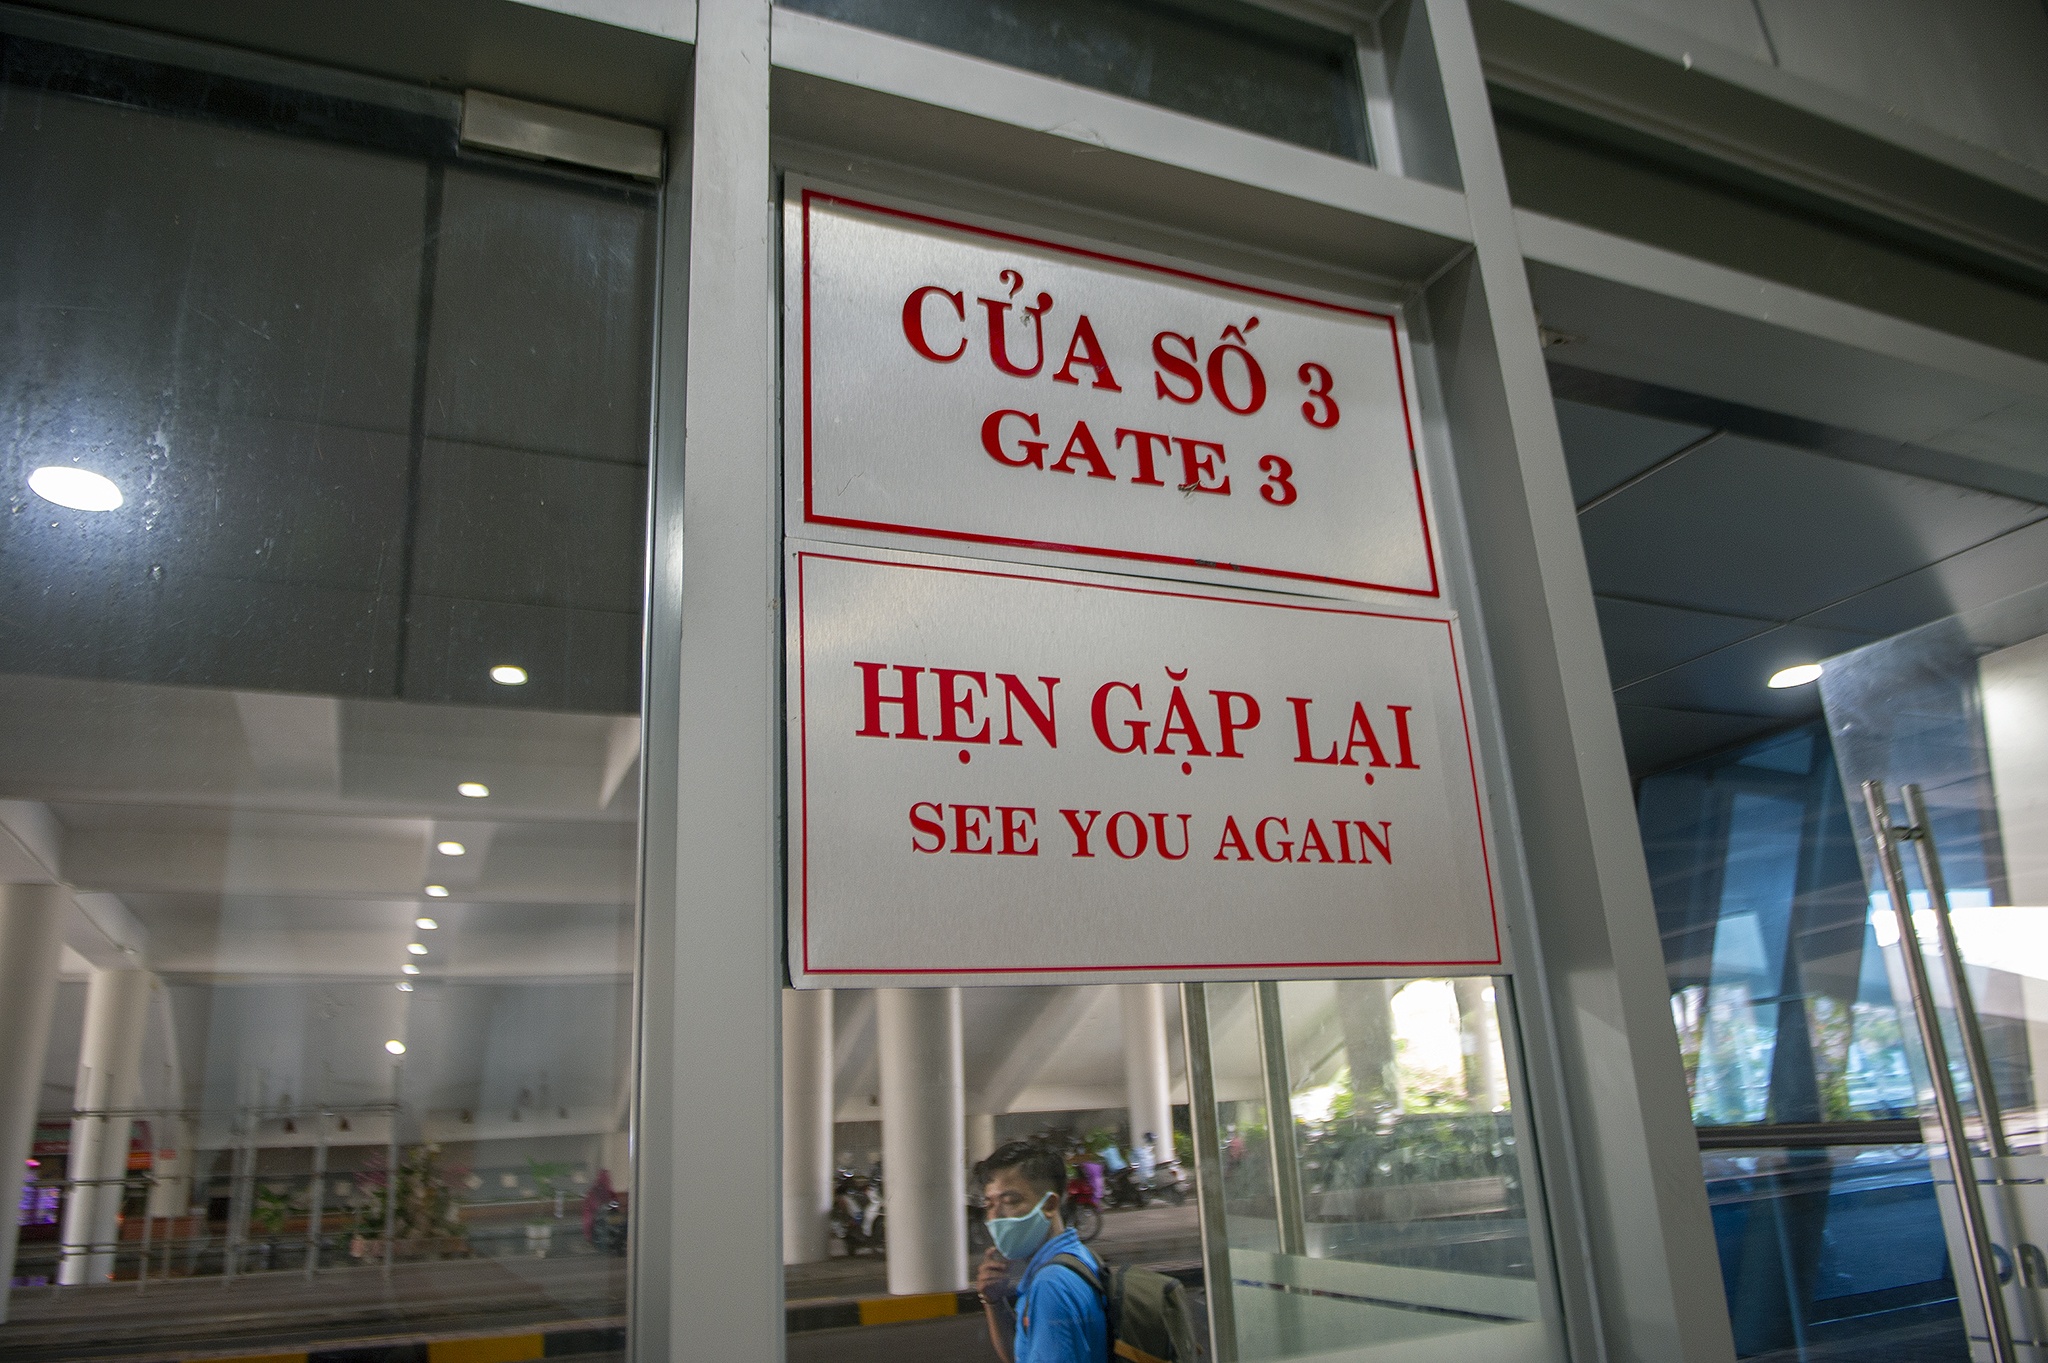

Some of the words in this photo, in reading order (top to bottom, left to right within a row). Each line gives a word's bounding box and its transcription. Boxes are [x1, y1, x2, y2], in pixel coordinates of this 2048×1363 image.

[902, 269, 1122, 392] CỬA
[1152, 316, 1267, 415] SỐ
[1298, 362, 1341, 429] 3
[981, 409, 1231, 496] GATE
[1259, 455, 1297, 506] 3
[854, 661, 1061, 764] HẸN
[1091, 665, 1261, 775] GẶP
[1286, 697, 1420, 785] LẠI
[909, 802, 1039, 856] SEE
[1059, 809, 1192, 861] YOU
[1214, 815, 1392, 865] AGAIN
